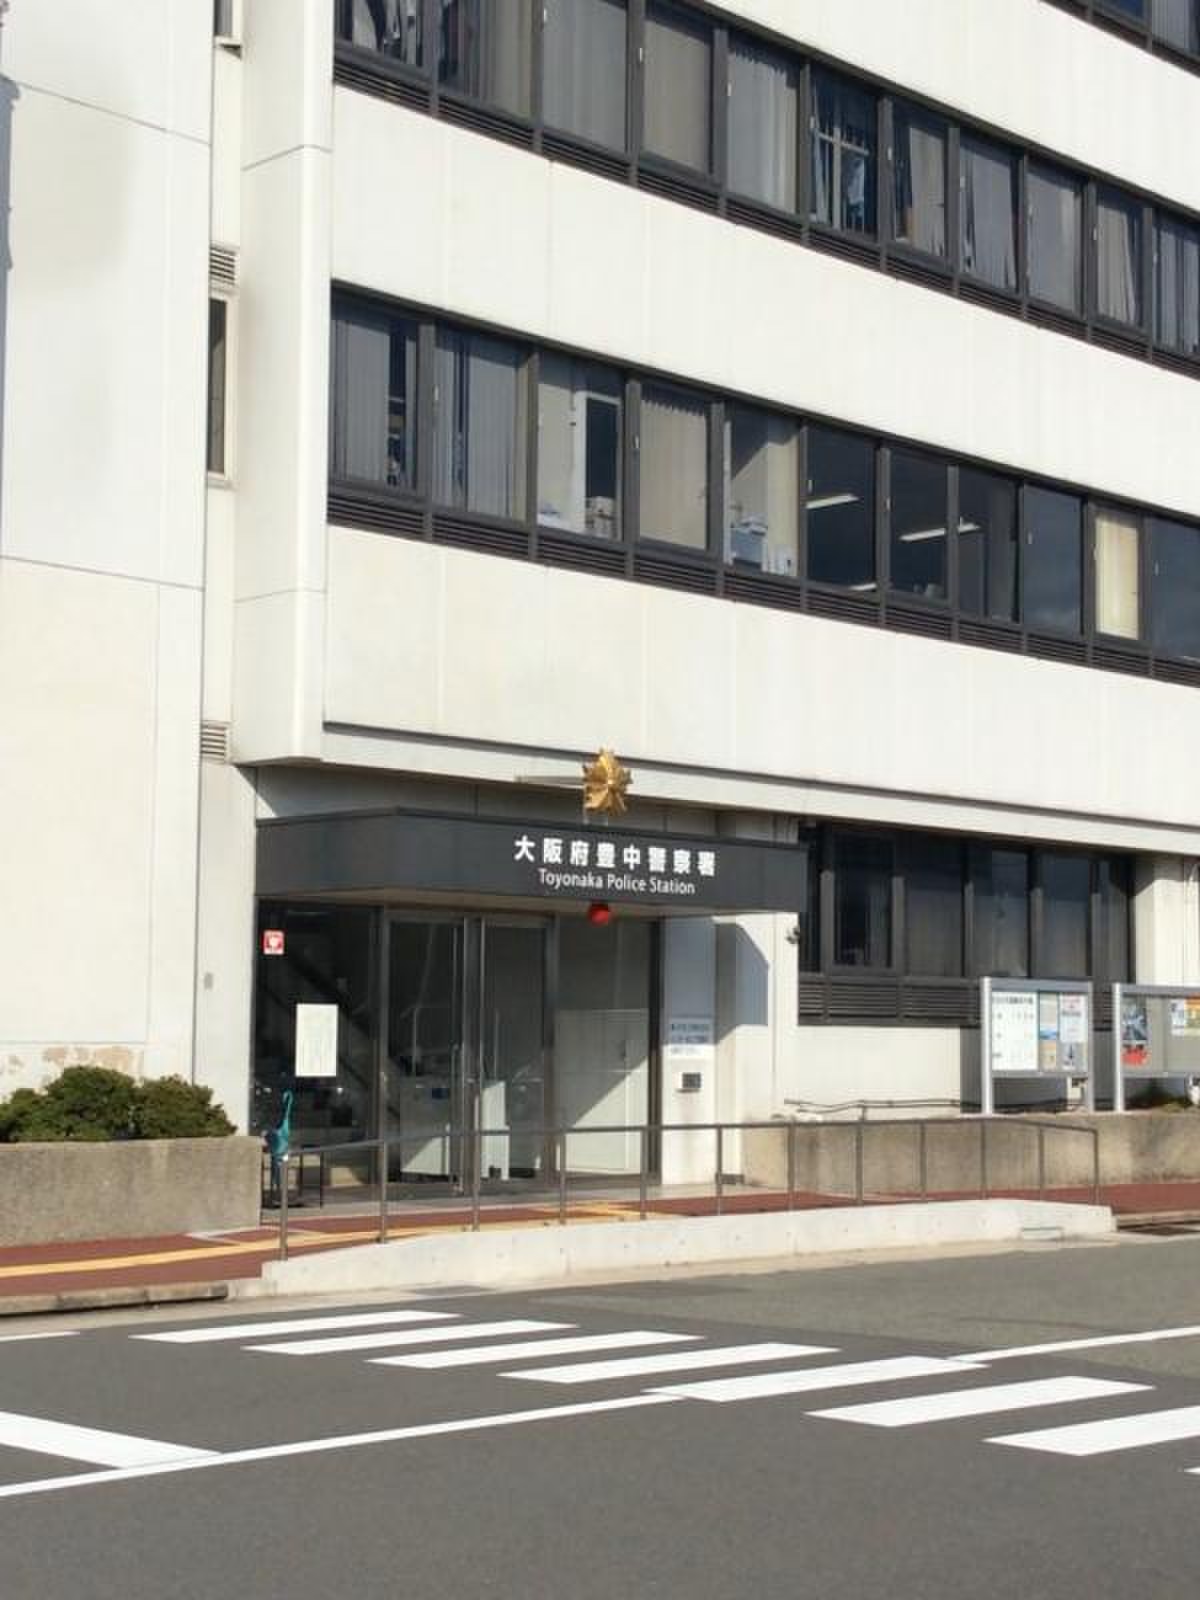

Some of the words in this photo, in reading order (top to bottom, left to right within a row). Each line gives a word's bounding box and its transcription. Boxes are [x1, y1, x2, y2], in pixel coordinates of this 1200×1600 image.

[514, 835, 716, 876] 大阪府豊中警察署
[538, 868, 603, 890] Toyonaka
[607, 873, 647, 892] Police
[649, 876, 696, 895] Station
